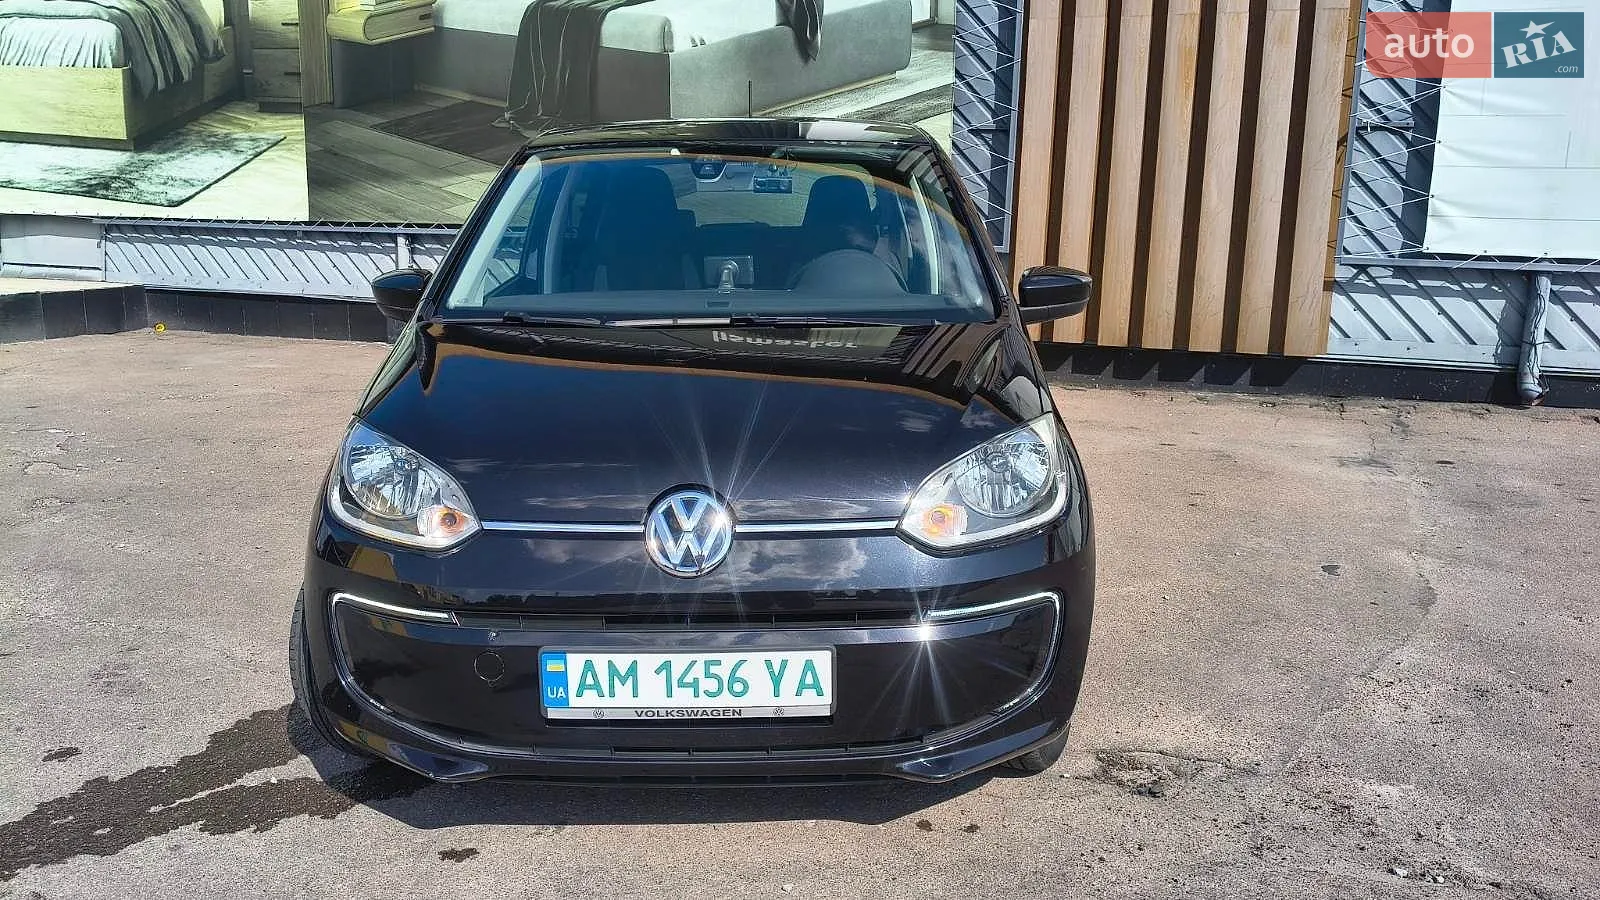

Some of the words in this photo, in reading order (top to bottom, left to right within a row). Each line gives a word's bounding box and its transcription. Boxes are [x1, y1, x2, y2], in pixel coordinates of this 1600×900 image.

[575, 659, 639, 698] AM
[654, 659, 750, 698] 1456
[764, 659, 825, 697] YA
[547, 686, 567, 698] UA
[634, 708, 742, 718] VOLKSWAGEN
